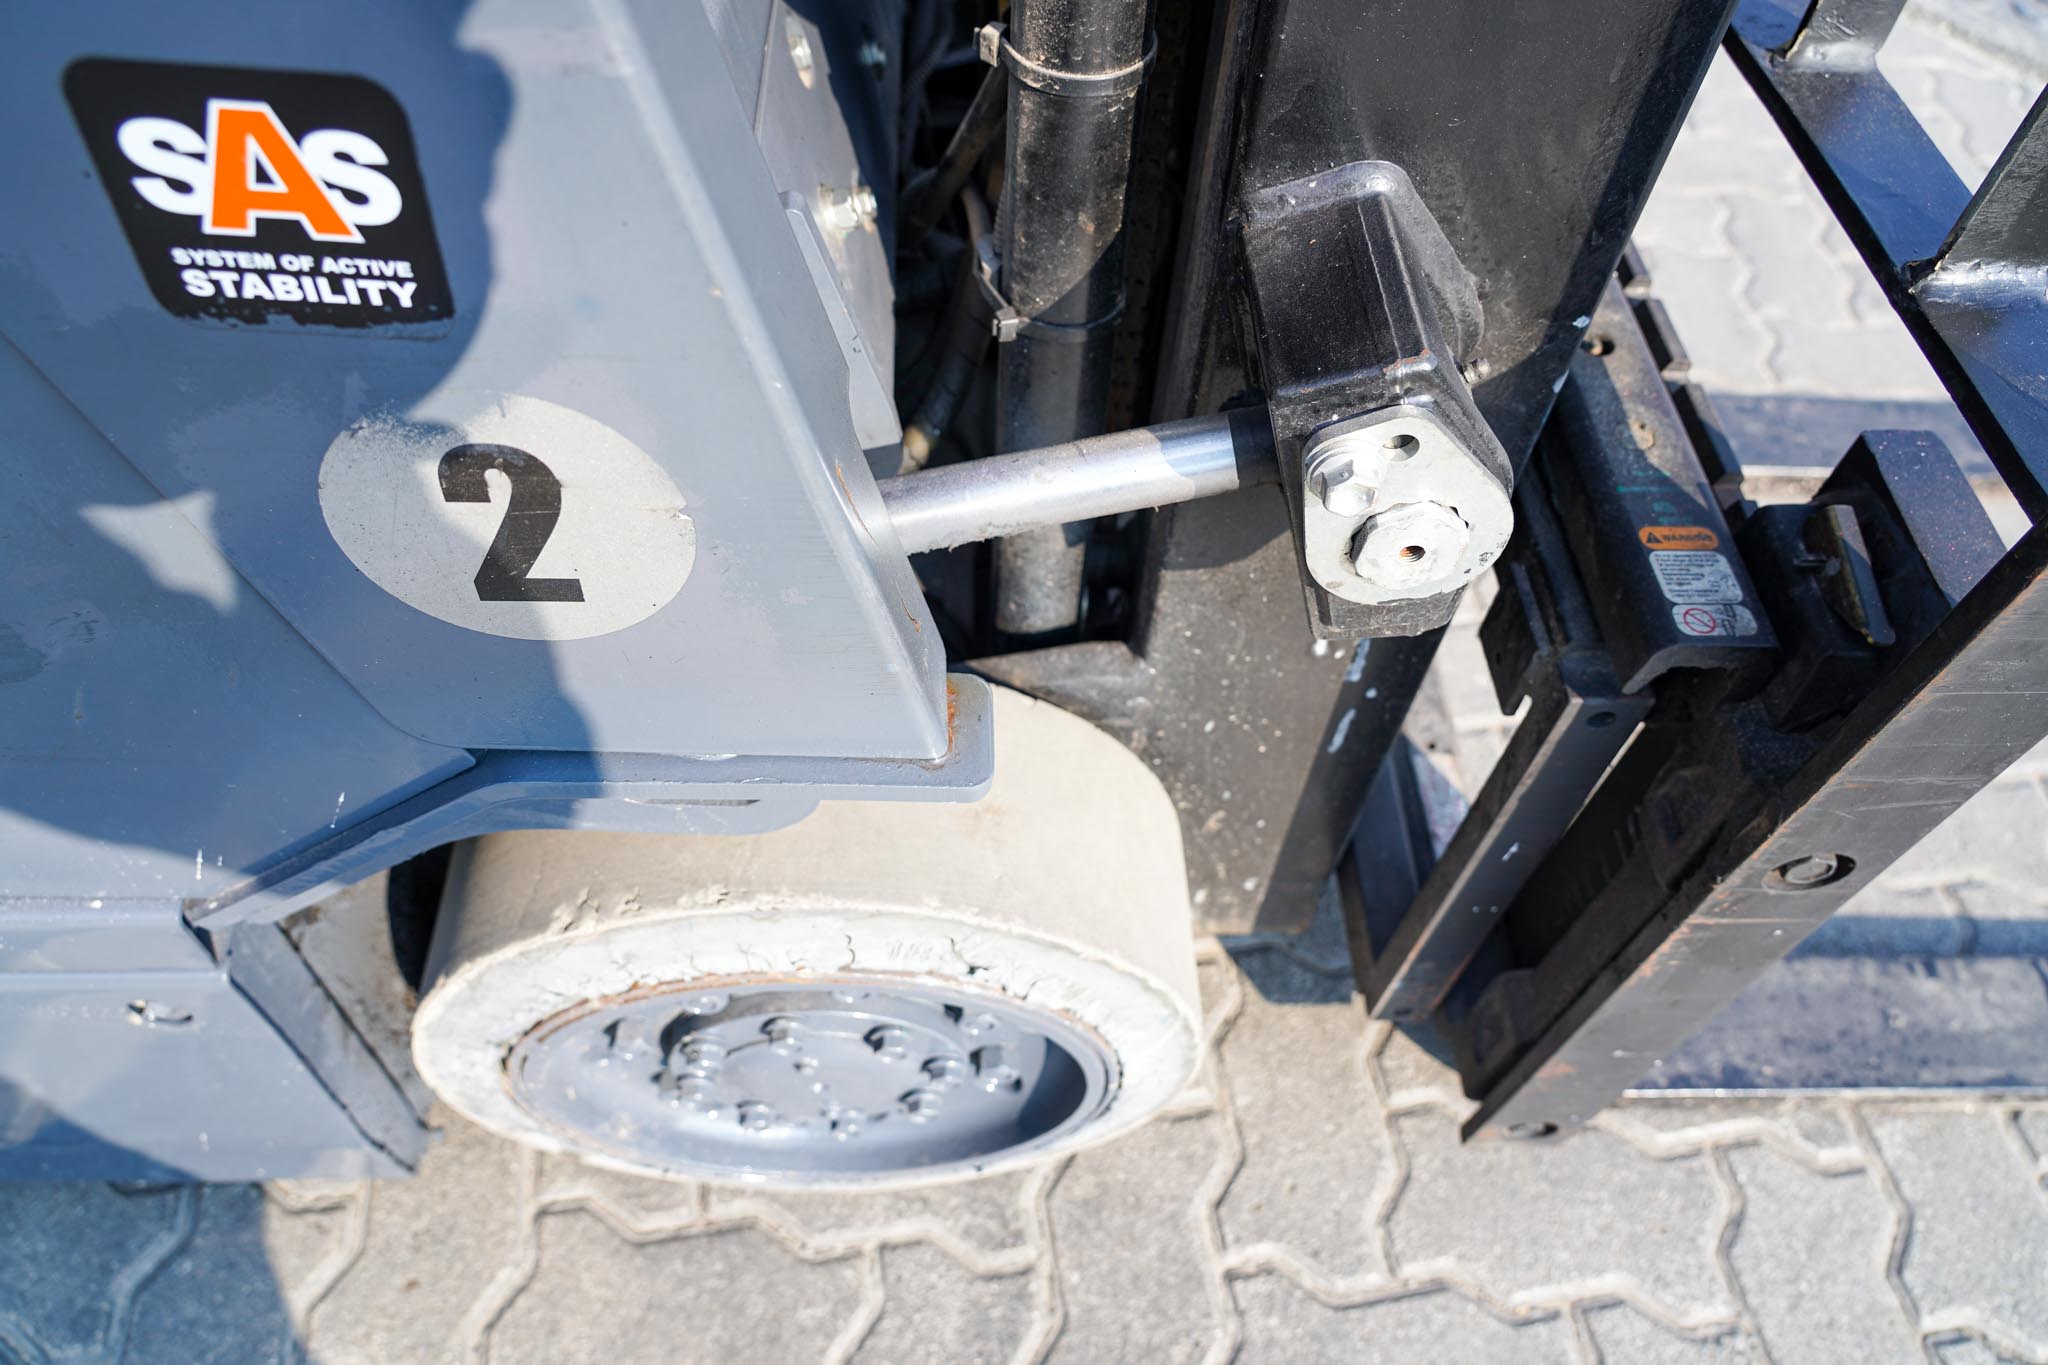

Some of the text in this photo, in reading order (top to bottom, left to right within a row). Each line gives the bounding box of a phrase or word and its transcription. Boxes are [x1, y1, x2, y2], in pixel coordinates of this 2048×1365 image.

[116, 97, 403, 244] SAS
[170, 247, 414, 278] SYSTEM OF ACTIVE
[181, 268, 417, 308] STABILITY
[438, 443, 585, 602] 2
